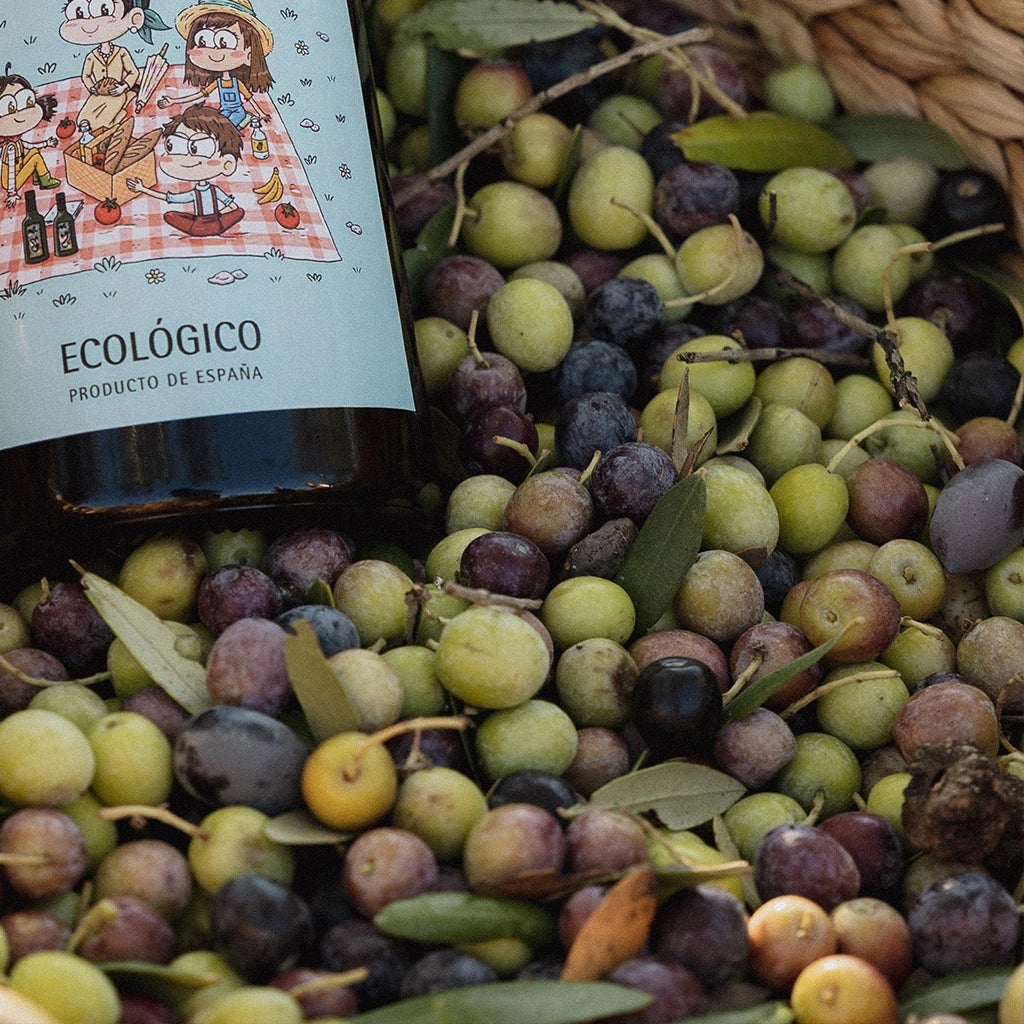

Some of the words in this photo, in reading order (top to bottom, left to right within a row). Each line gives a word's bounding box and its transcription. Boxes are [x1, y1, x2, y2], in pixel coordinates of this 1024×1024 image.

[61, 318, 261, 374] ECOLÓGICO
[69, 376, 158, 402] PRODUCTO
[168, 372, 187, 387] DE
[197, 364, 263, 383] ESPAÑA
